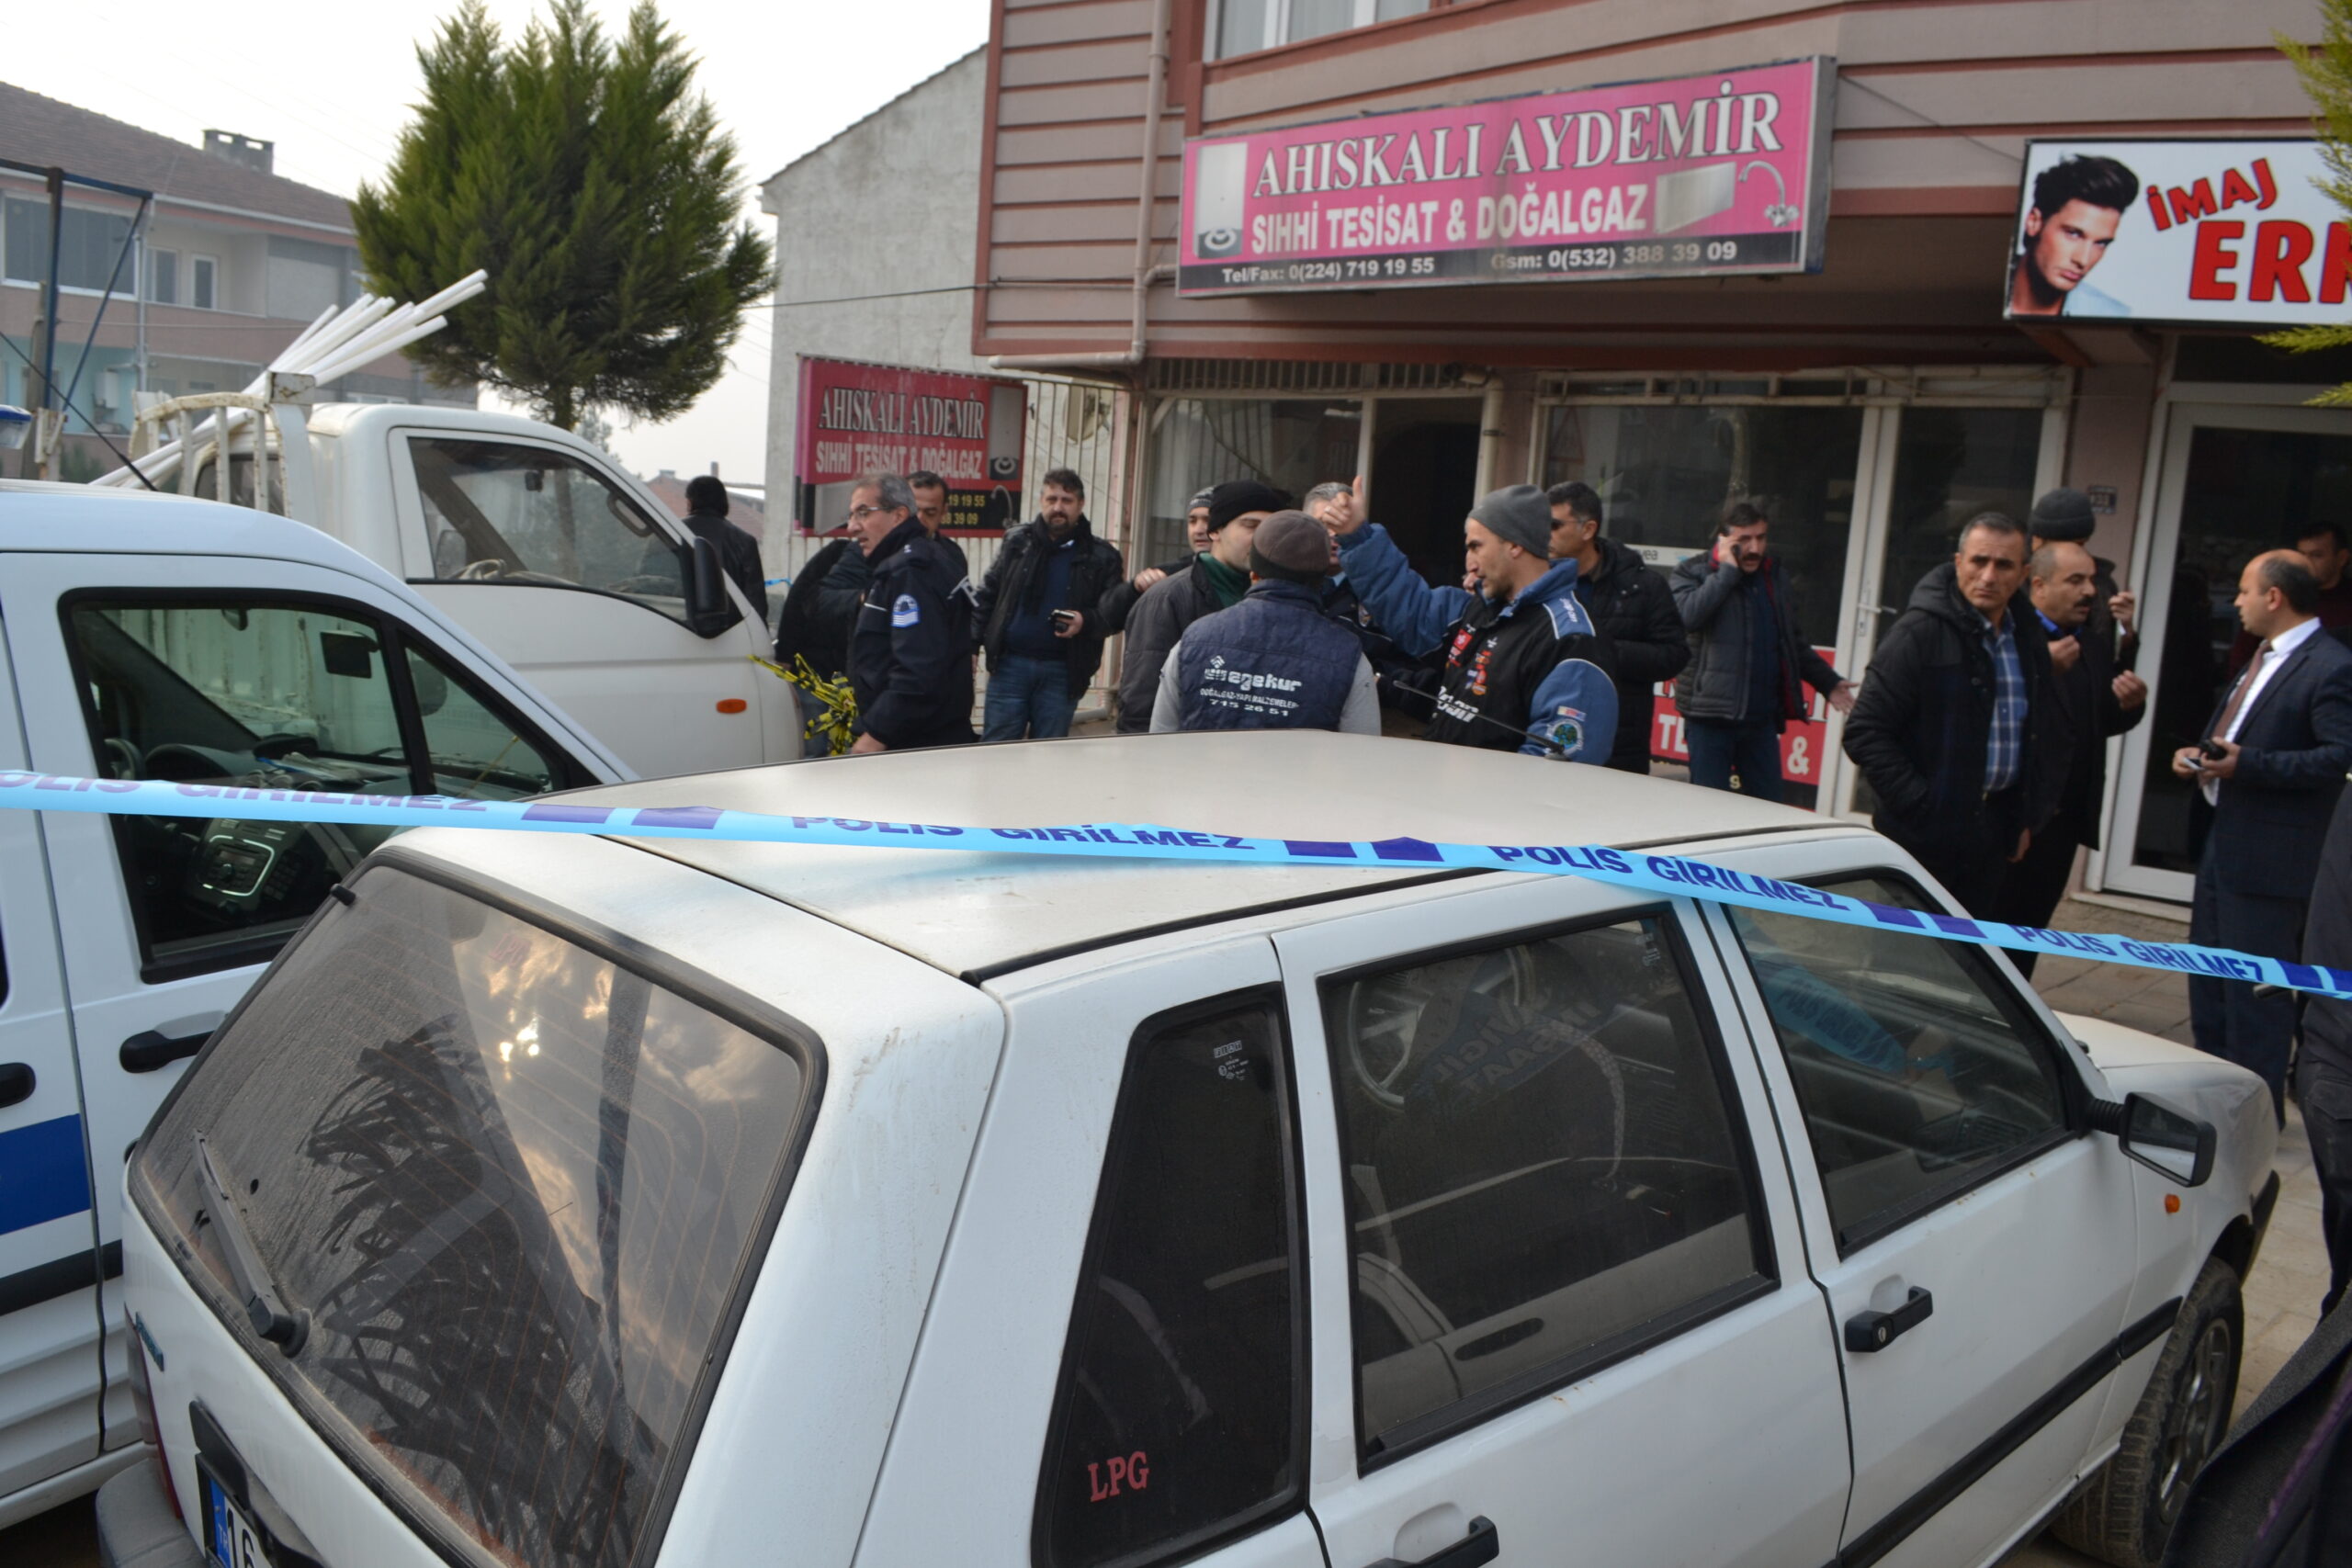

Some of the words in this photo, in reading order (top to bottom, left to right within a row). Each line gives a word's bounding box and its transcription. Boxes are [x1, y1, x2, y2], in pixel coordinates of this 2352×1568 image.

[1251, 122, 1485, 198] AHISKALI
[1495, 80, 1782, 175] AYDEMİR
[2146, 157, 2278, 231] İMAJ
[1251, 199, 1319, 255] SIHHİ
[1326, 196, 1440, 250] TESİSAT
[1446, 199, 1468, 243] &
[1476, 182, 1648, 241] DOĞALGAZ
[1347, 260, 1379, 277] 719
[1384, 258, 1407, 275] 19
[1411, 256, 1435, 274] 55
[1491, 254, 1543, 269] Gsm:
[1547, 247, 1617, 271] 0(532)
[1623, 244, 1665, 265] 388
[1672, 243, 1700, 262] 39
[1706, 240, 1737, 261] 09
[819, 387, 906, 434] AHISKALI
[908, 390, 986, 440] AYDEMİR
[816, 435, 853, 474] SIHHİ
[922, 443, 983, 479] DOĞALGAZ
[1787, 736, 1809, 774] &
[0, 773, 141, 794] OLIS
[1088, 1450, 1149, 1503] LPG
